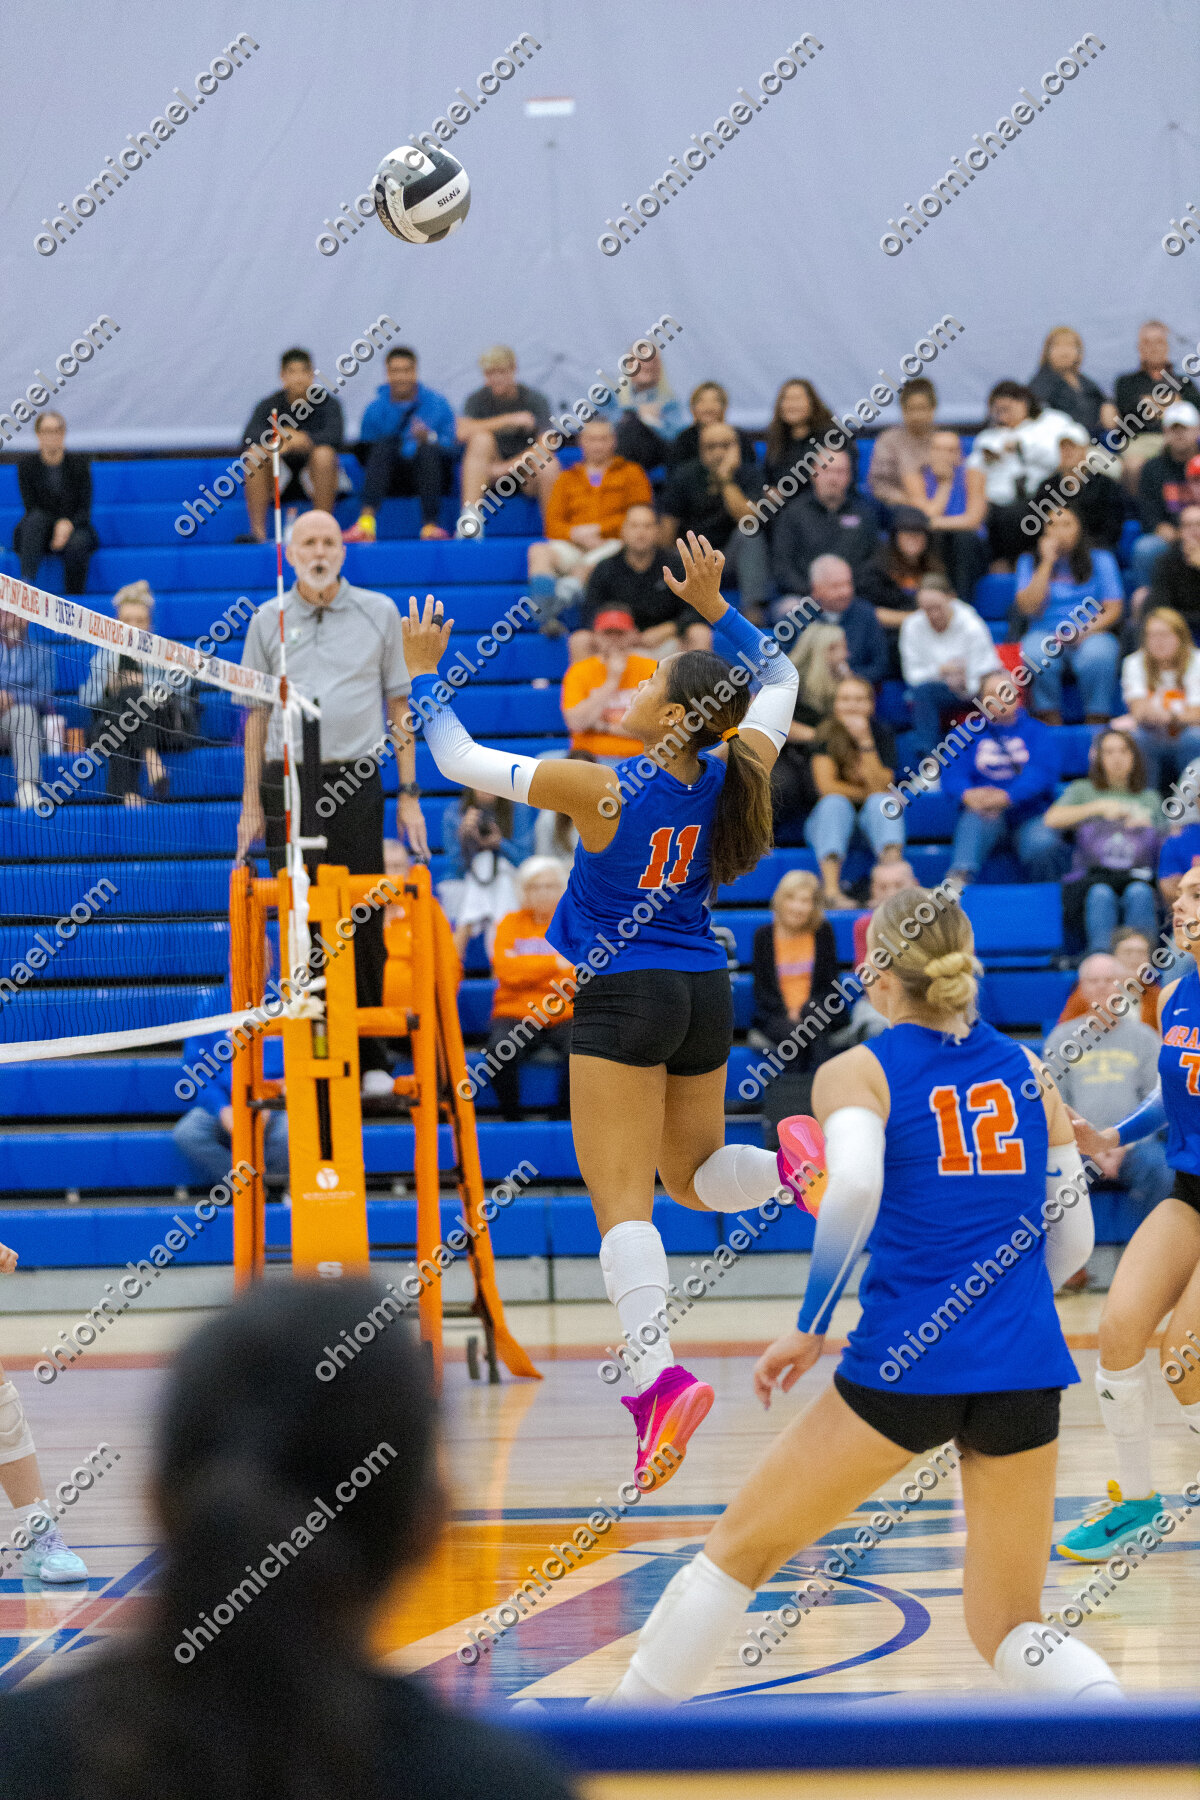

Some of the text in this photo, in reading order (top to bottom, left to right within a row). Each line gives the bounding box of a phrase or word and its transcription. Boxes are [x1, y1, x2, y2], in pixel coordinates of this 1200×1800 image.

[637, 825, 702, 889] 11
[1164, 1025, 1200, 1050] ORA
[929, 1079, 1026, 1175] 12
